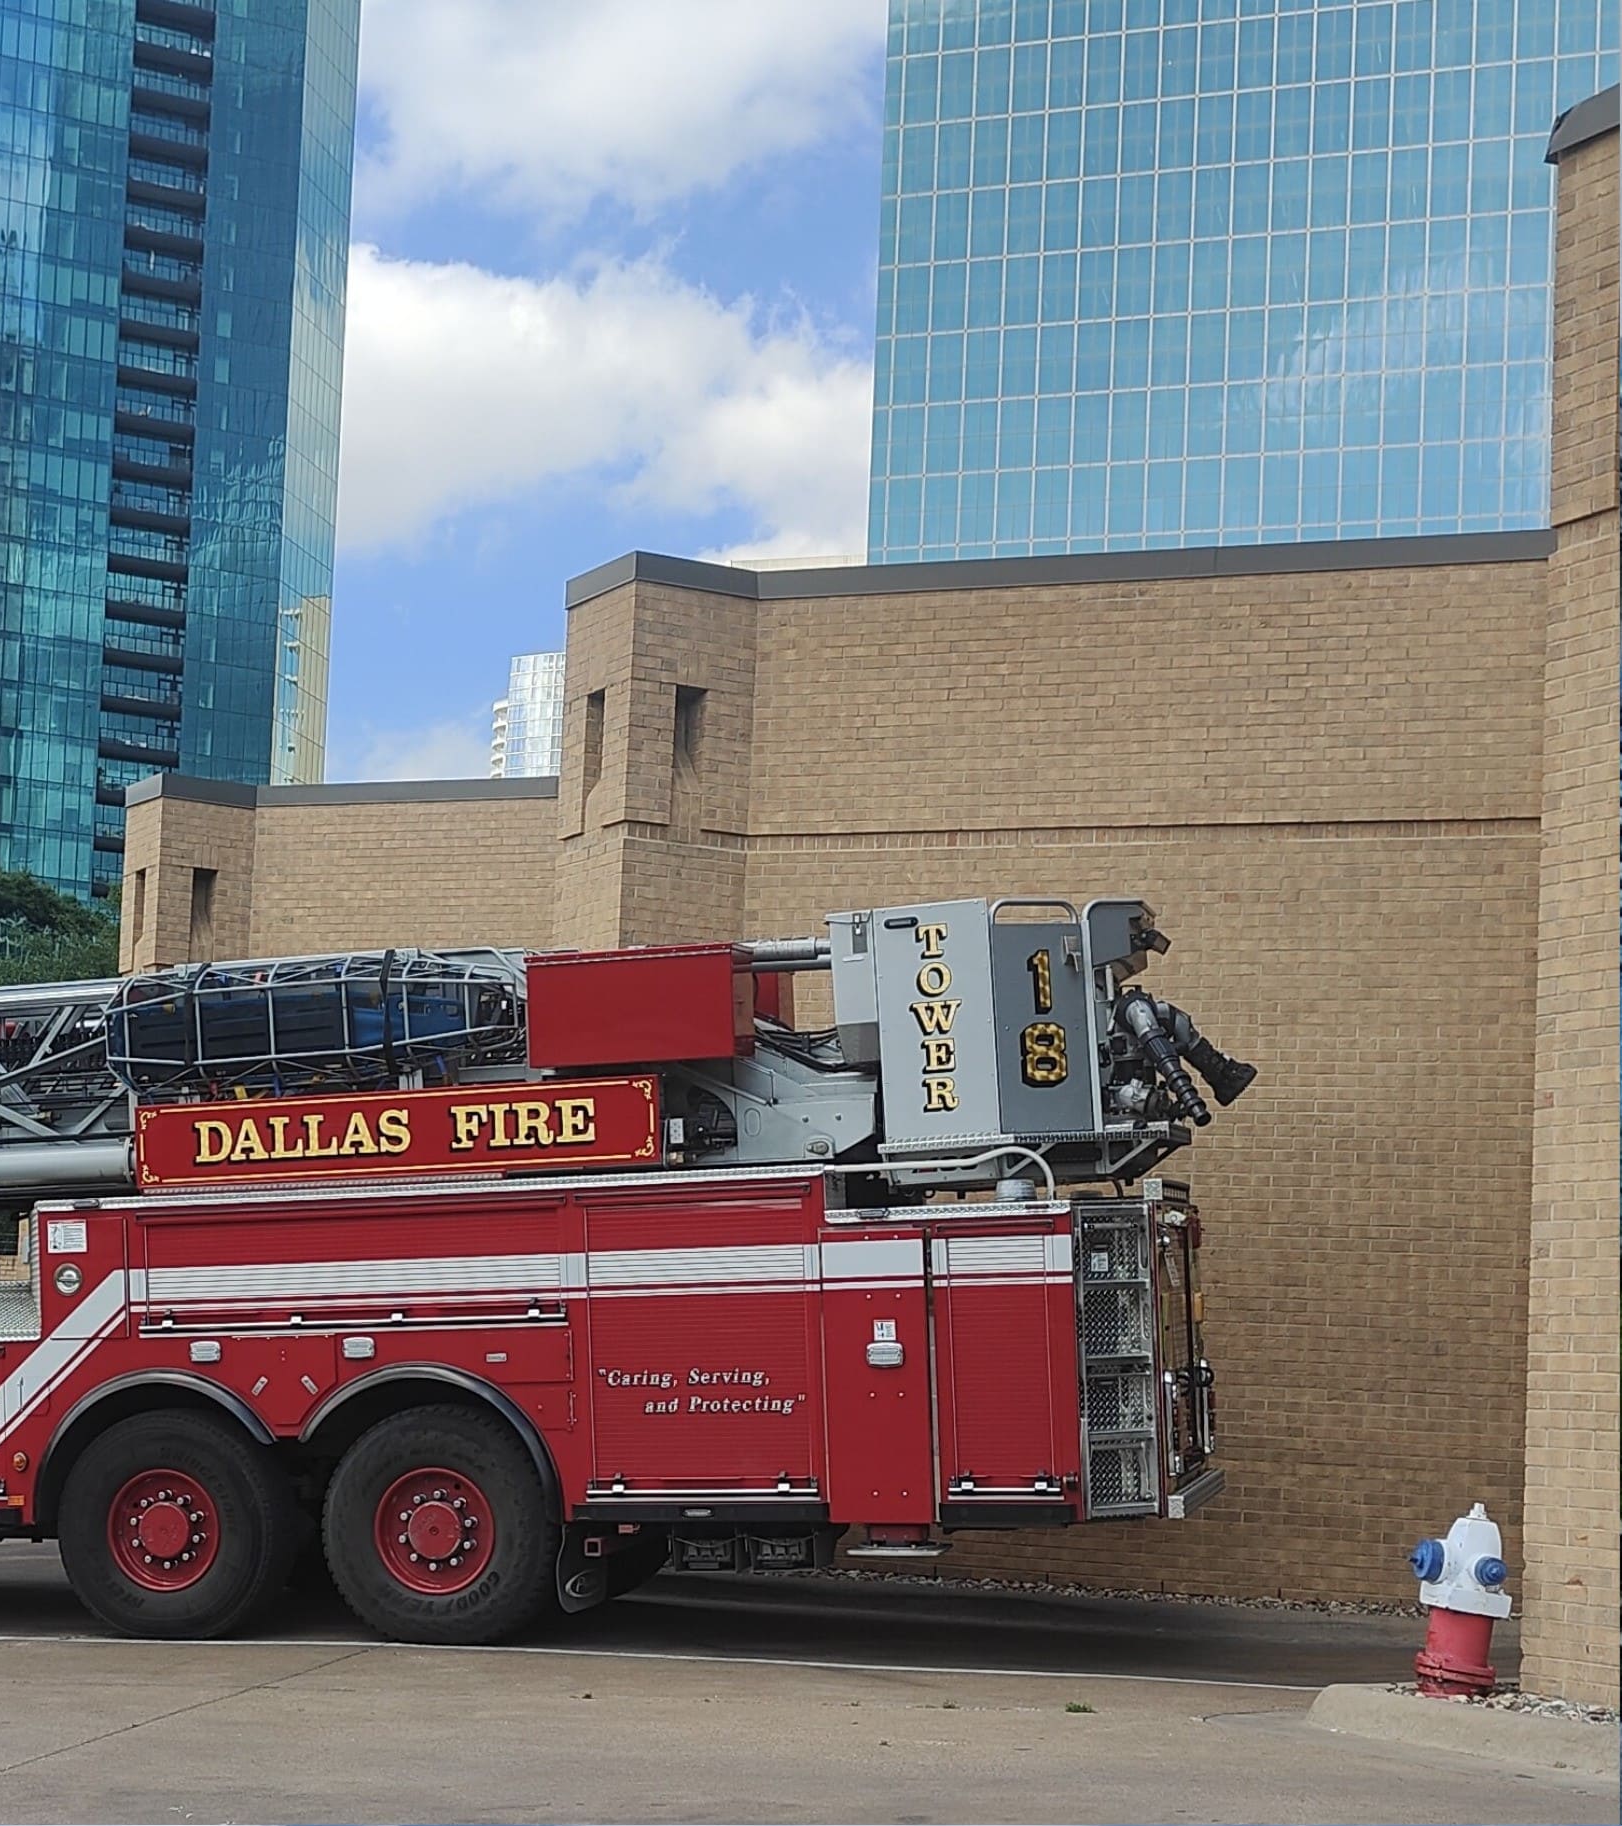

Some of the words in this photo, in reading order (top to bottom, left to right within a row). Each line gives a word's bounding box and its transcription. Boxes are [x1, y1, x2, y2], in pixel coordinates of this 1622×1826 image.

[910, 922, 962, 1113] TOWER
[193, 1108, 411, 1165] DALLAS
[450, 1097, 596, 1151] FIRE
[688, 1367, 771, 1388] Serving,
[644, 1398, 679, 1414] and
